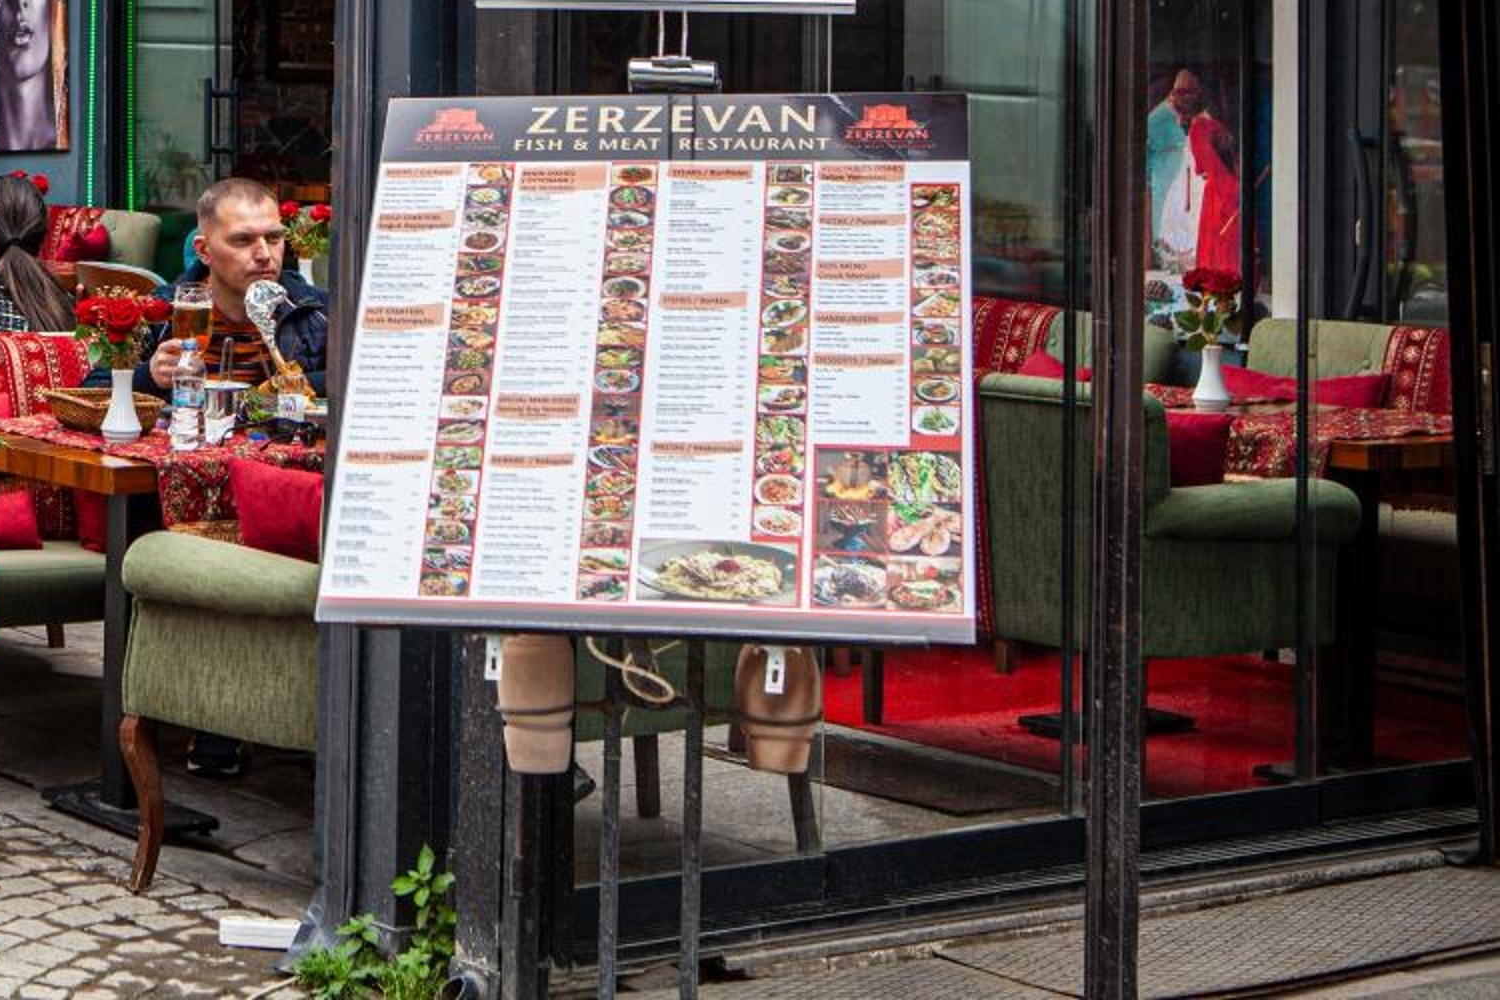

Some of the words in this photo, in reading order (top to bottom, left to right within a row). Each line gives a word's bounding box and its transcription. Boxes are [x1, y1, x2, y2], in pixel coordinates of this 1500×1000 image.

[527, 104, 817, 134] ZERZEVAN
[844, 128, 930, 140] ZERZEVAN
[514, 138, 563, 151] FISH
[573, 138, 588, 151] &
[599, 138, 661, 151] MEAT
[678, 136, 832, 151] RESTAURANT
